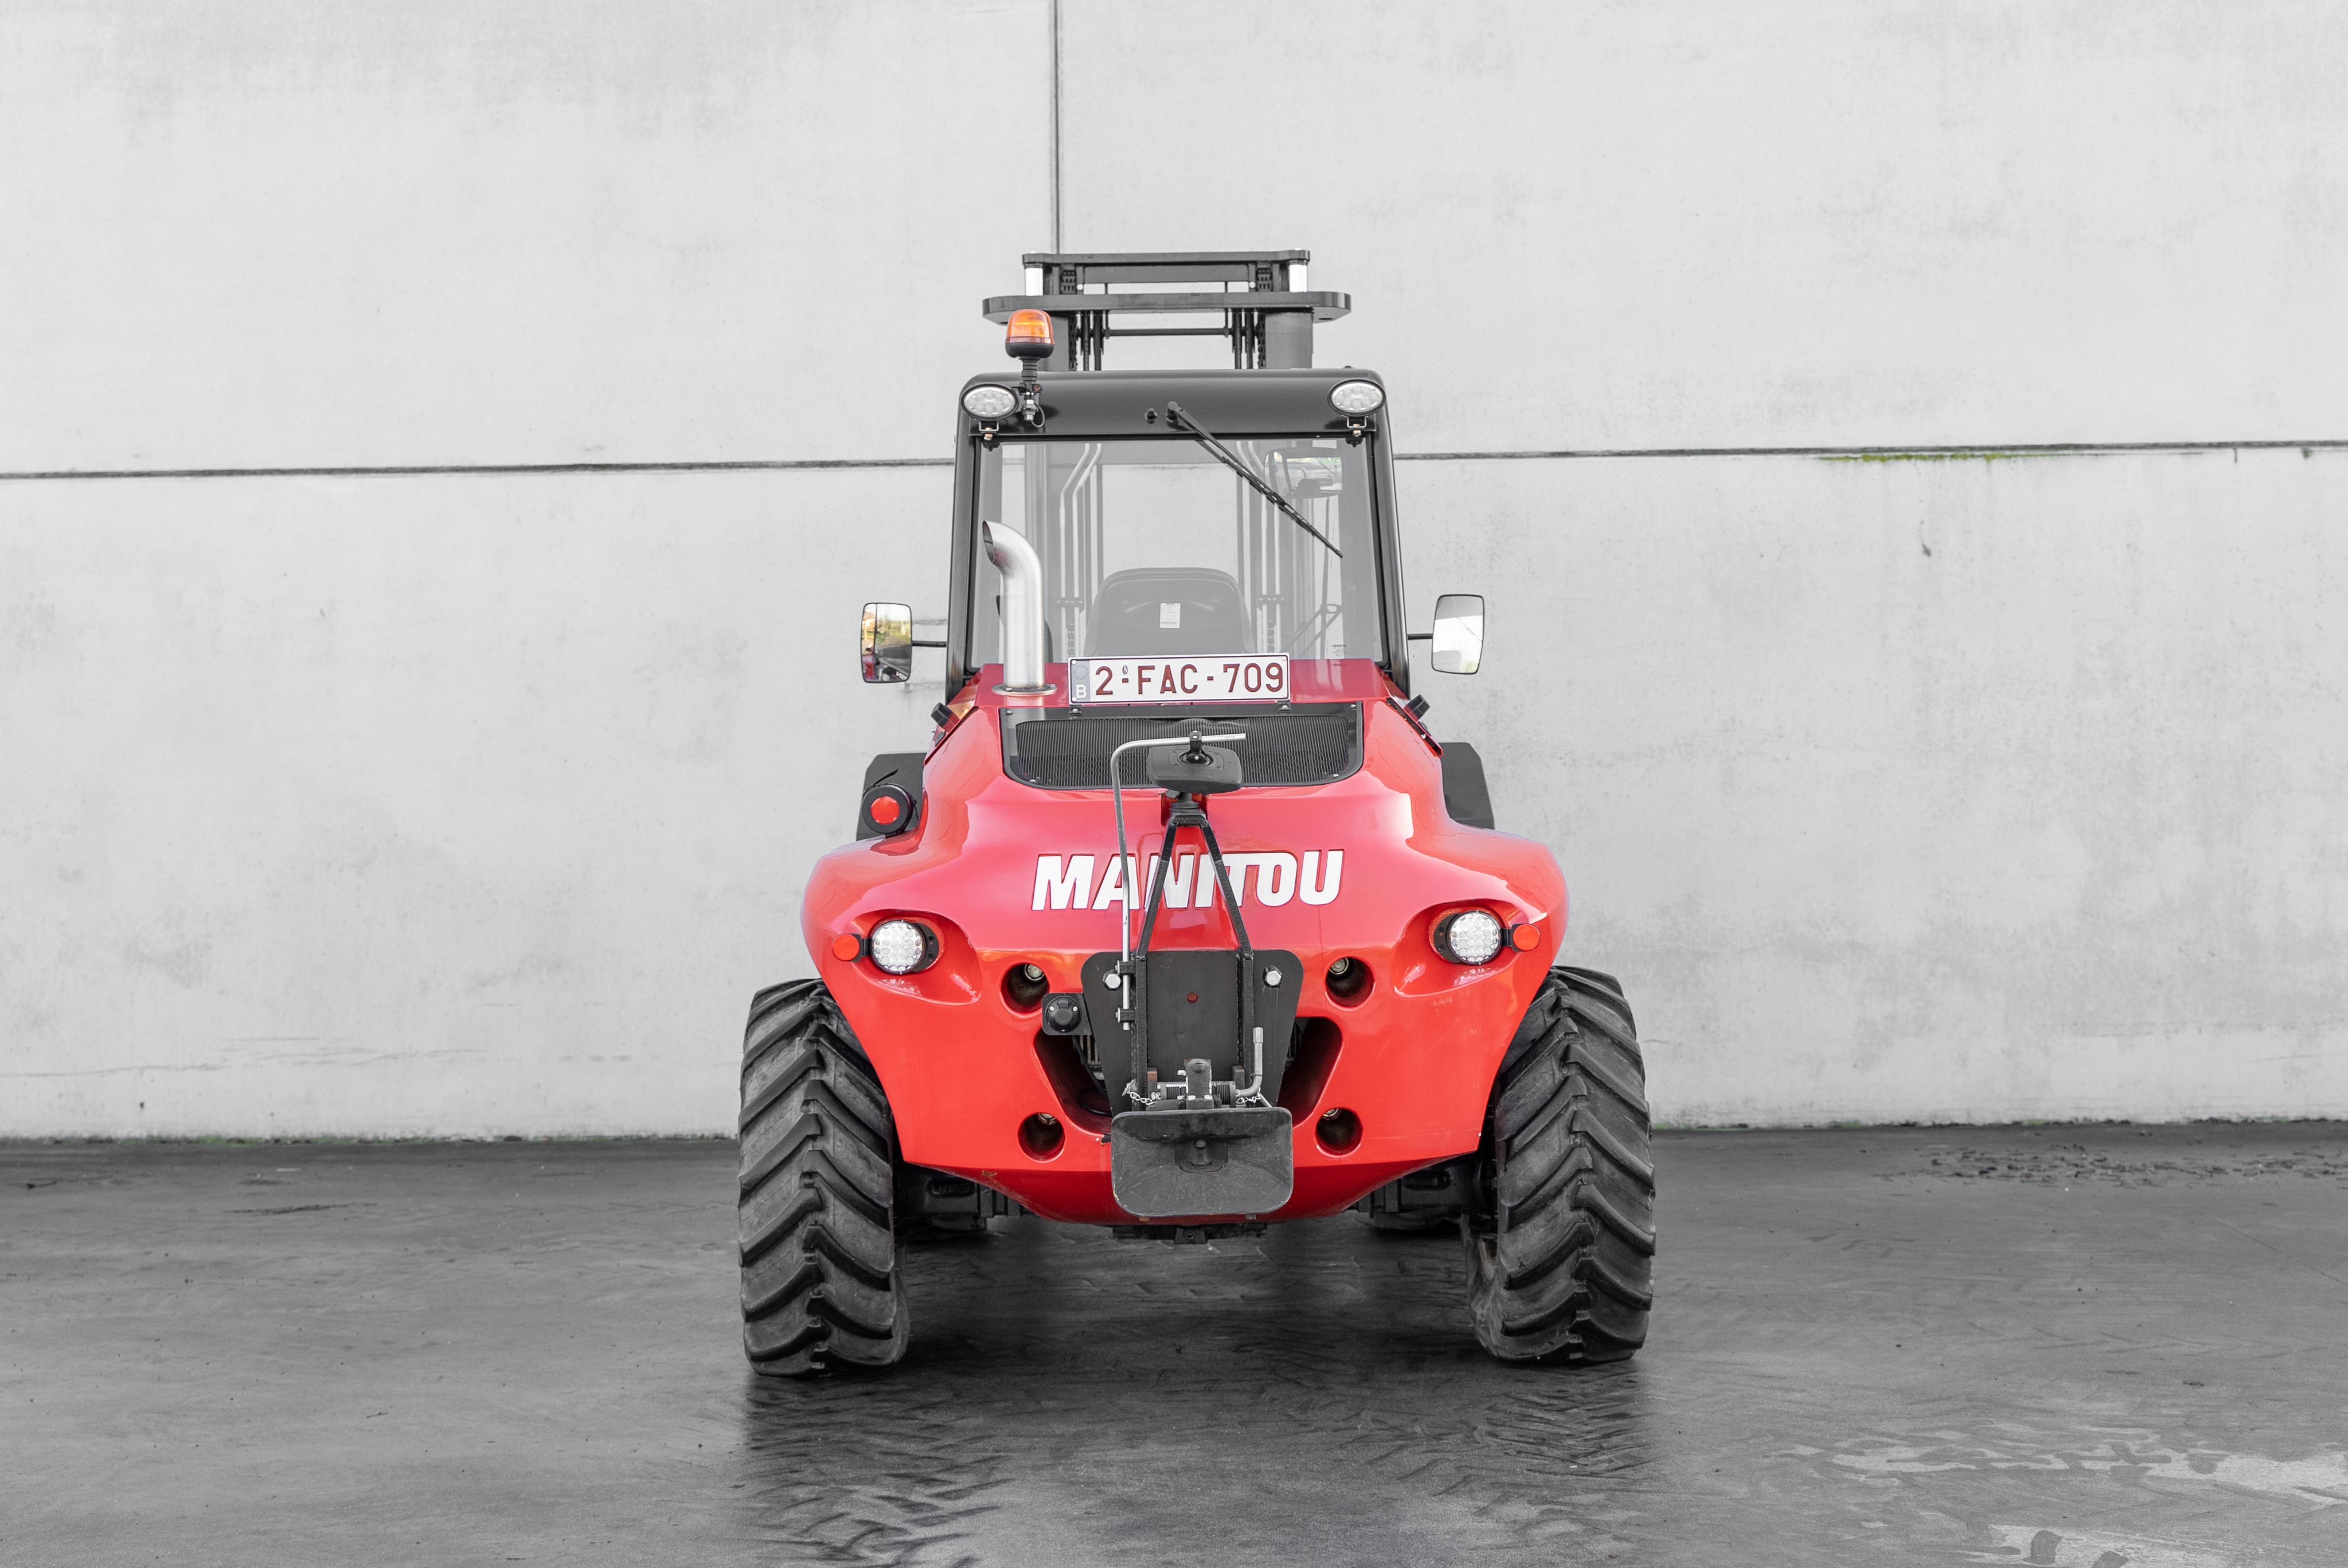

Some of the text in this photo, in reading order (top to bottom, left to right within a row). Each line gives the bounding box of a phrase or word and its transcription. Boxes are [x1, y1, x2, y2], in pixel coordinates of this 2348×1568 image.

[1076, 684, 1087, 698] B
[1095, 663, 1283, 695] 2-FAC-709
[1032, 849, 1344, 910] MANITOU
